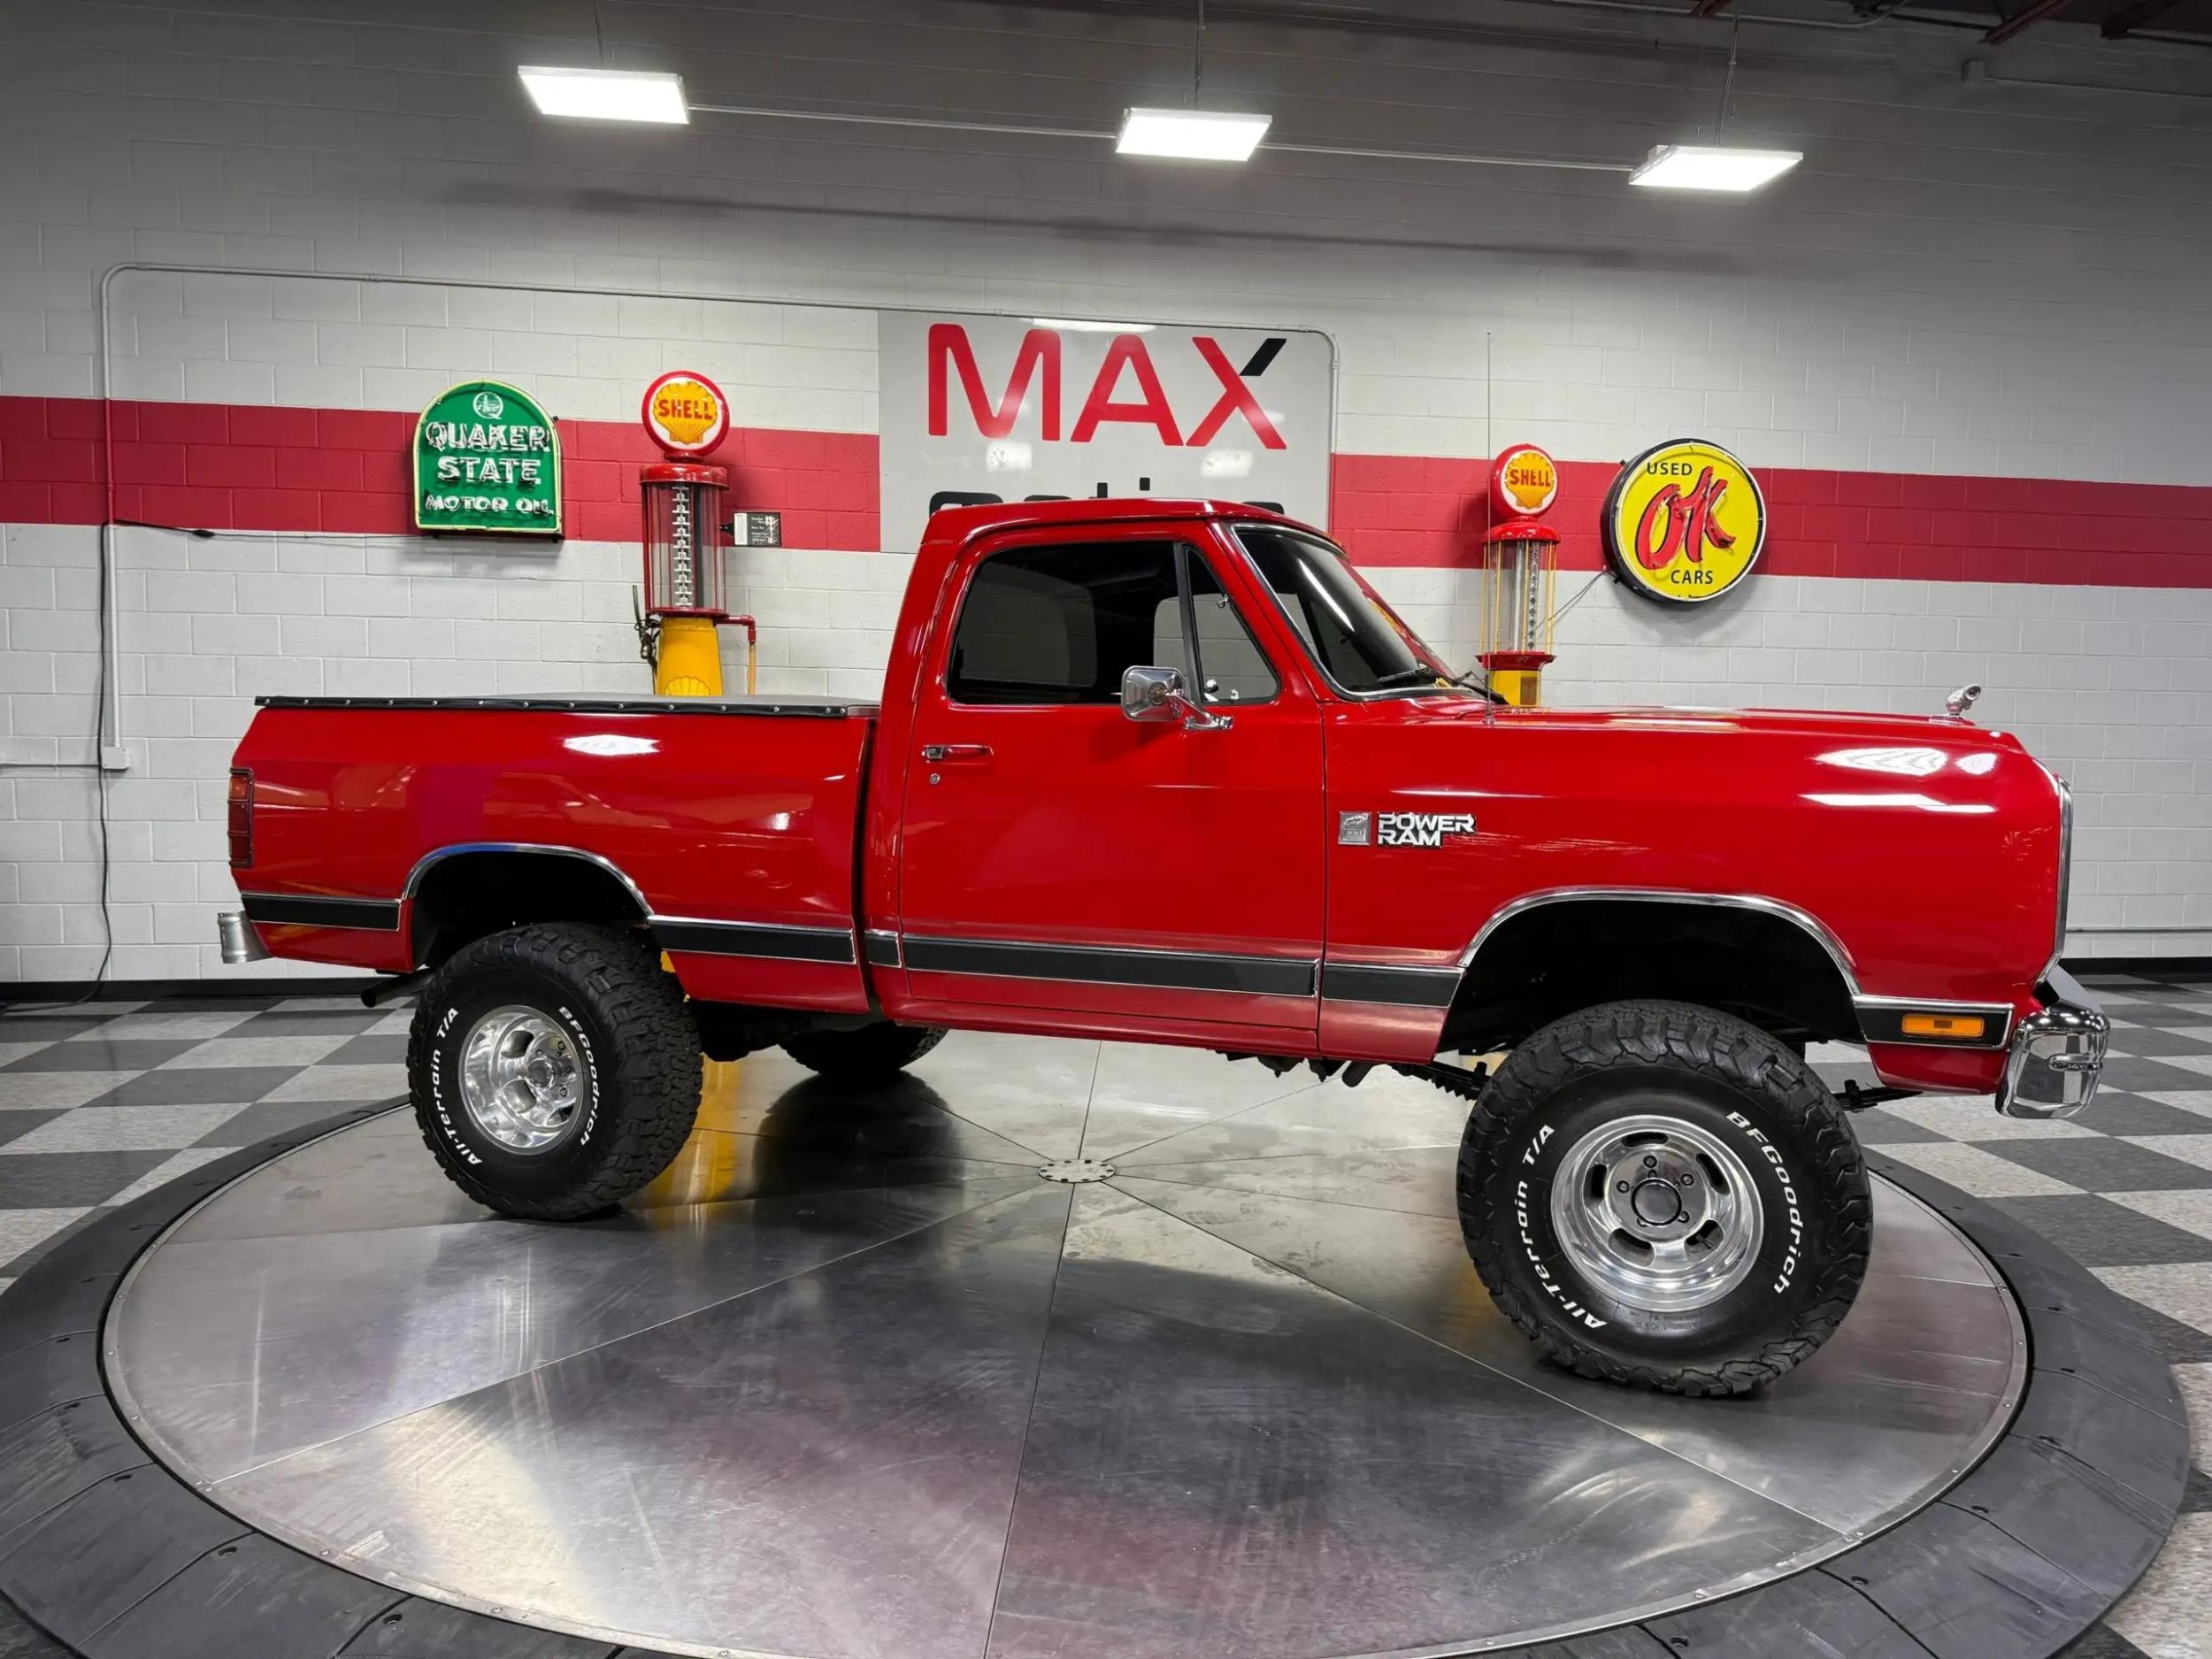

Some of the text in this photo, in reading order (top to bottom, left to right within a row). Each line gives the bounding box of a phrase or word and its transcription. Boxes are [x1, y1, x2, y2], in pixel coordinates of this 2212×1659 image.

[928, 323, 1287, 450] MAX
[658, 399, 714, 420] SHELL
[426, 422, 550, 452] QUAKER
[437, 456, 541, 485] STATE
[1509, 468, 1552, 488] SHELL
[1647, 462, 1694, 476] USED
[426, 494, 555, 516] MOTOR OIL
[1635, 465, 1736, 570] OK
[1671, 569, 1714, 585] CARS
[1378, 813, 1477, 833] POWER
[1378, 830, 1440, 846] RAM
[430, 1007, 483, 1165] All-Terrain T/A
[558, 1006, 600, 1147] BFGoodrich
[1724, 1110, 1804, 1295] BFGoodrich
[1515, 1124, 1608, 1329] All-Terrain T/A
